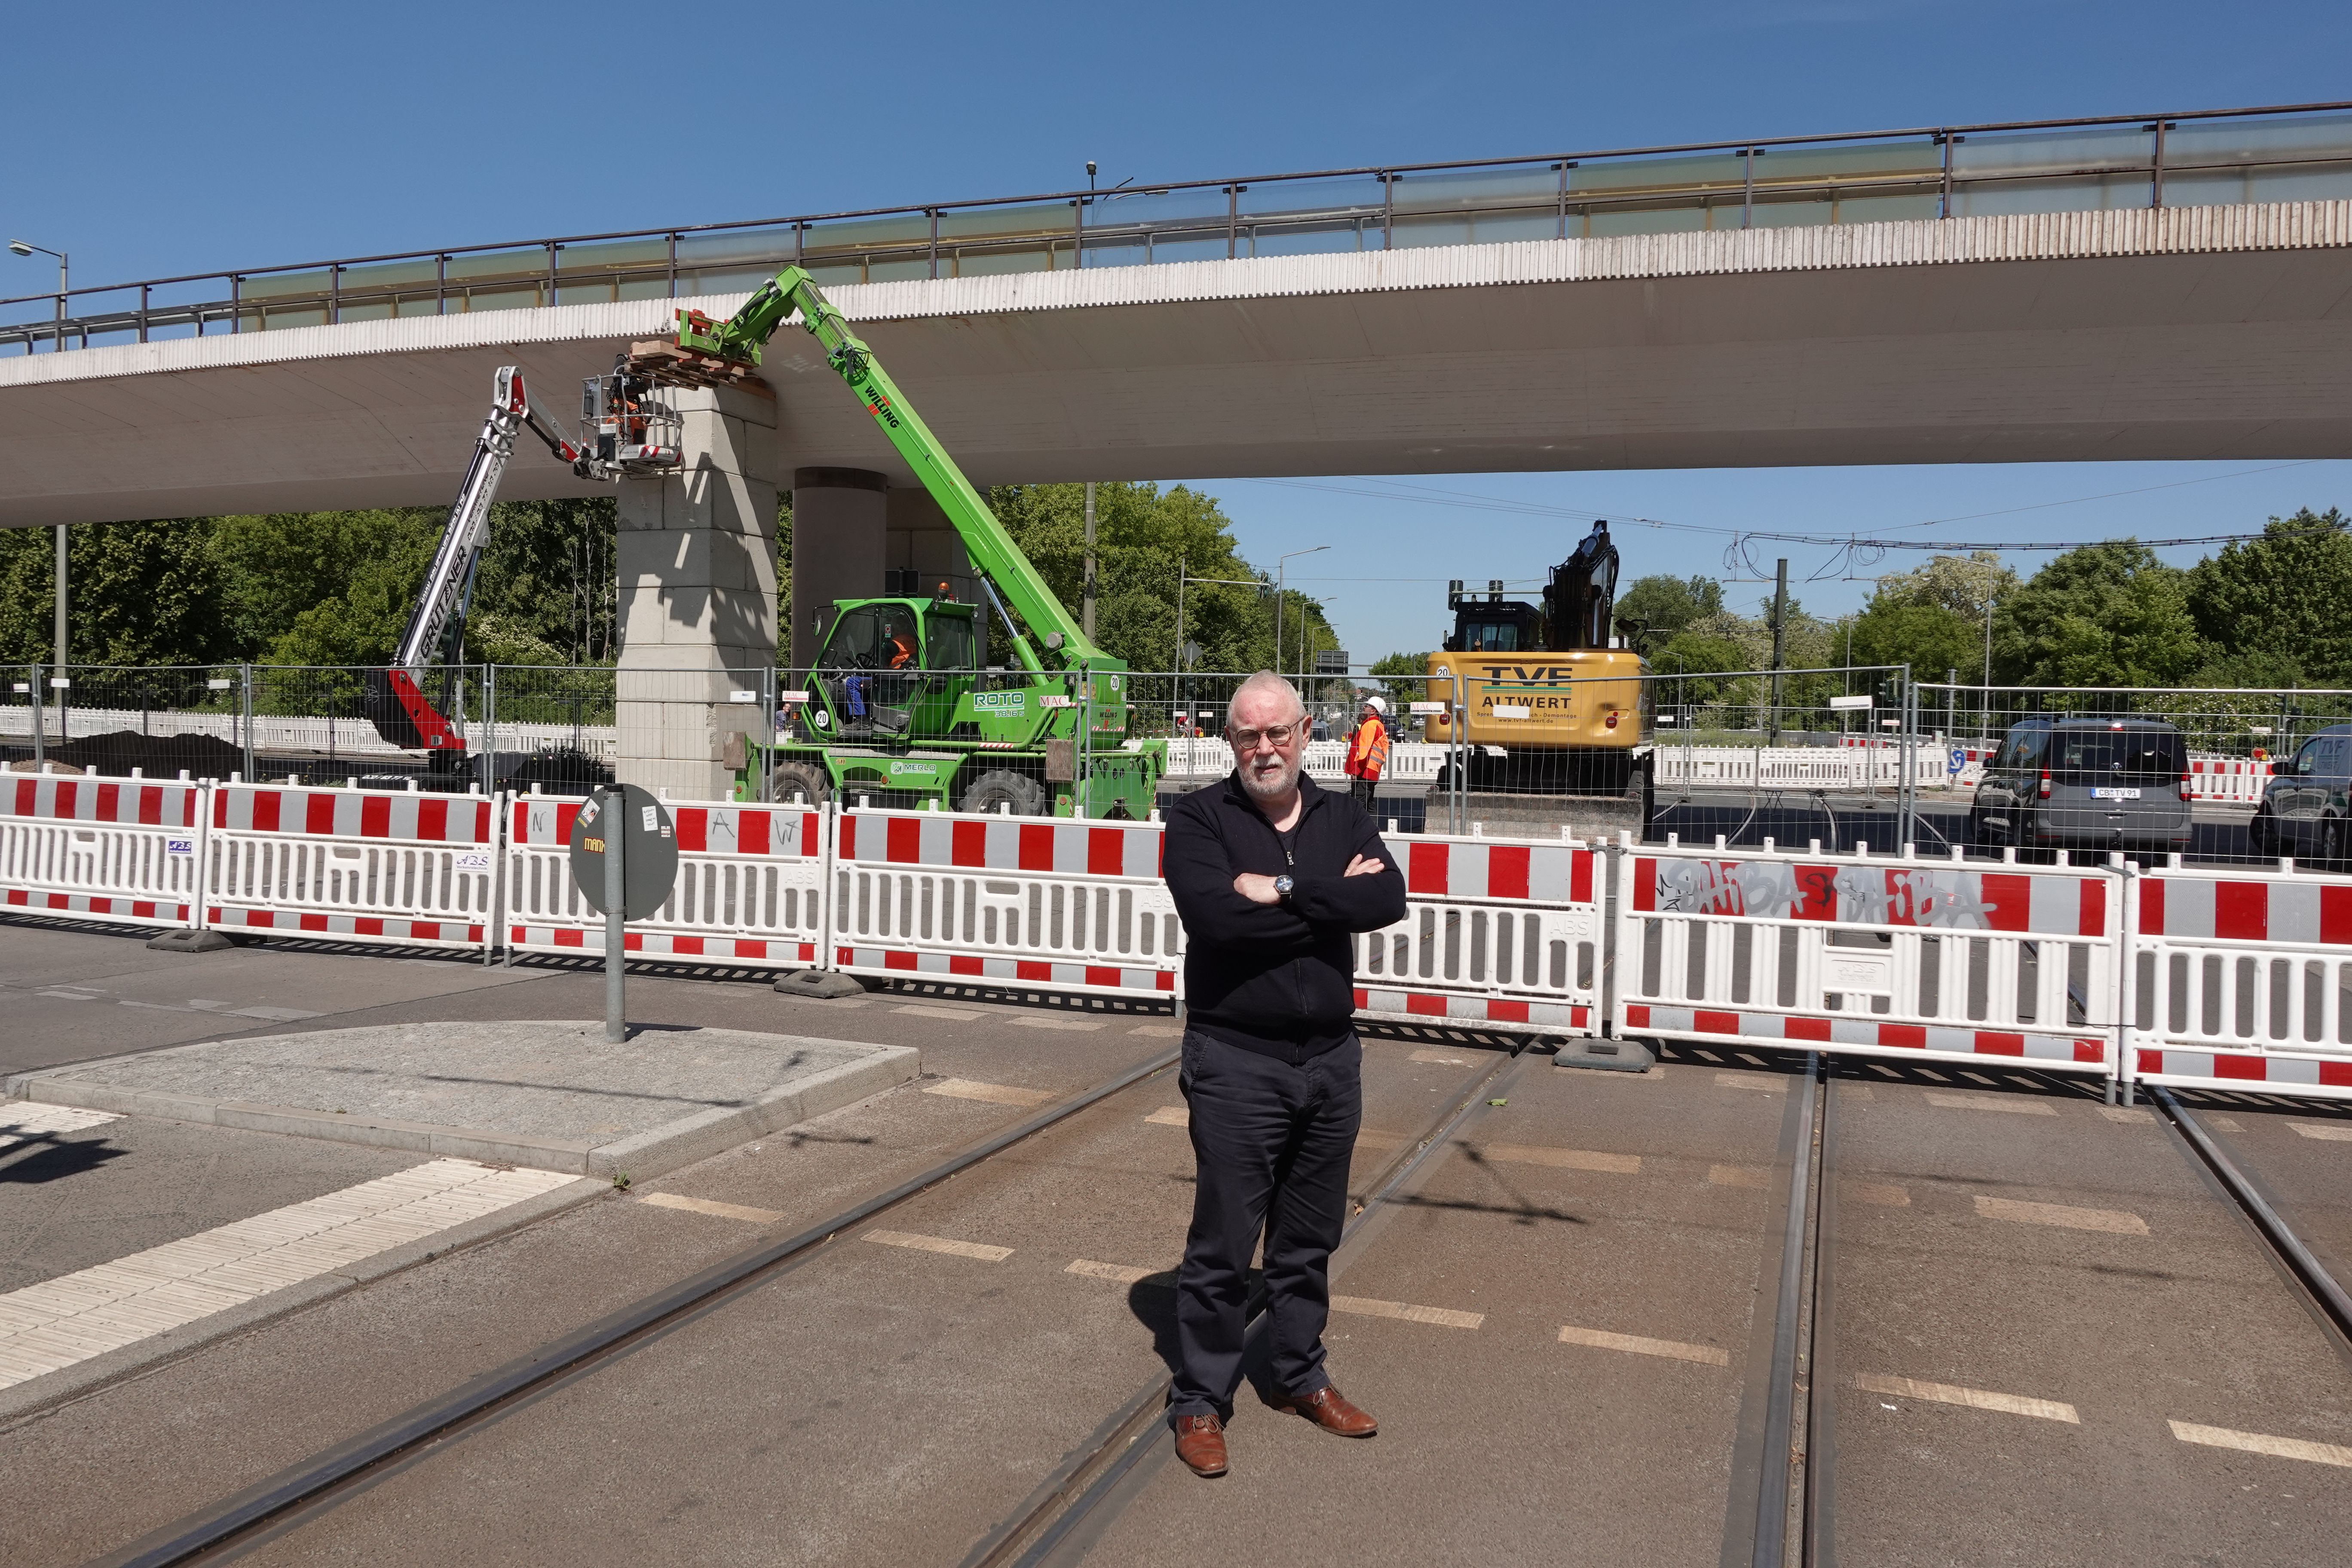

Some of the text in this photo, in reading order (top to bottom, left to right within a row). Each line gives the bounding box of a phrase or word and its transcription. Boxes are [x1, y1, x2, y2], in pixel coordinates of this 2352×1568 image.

[865, 385, 899, 428] WILLING
[420, 545, 467, 658] GRÜTZNER
[1438, 668, 1448, 677] 20
[1482, 667, 1572, 686] TVF
[1112, 678, 1118, 688] 20
[974, 692, 1025, 706] ROTO
[1040, 696, 1067, 706] MAC
[818, 713, 826, 723] 20
[456, 855, 488, 866] ABS
[1550, 918, 1589, 935] ABS
